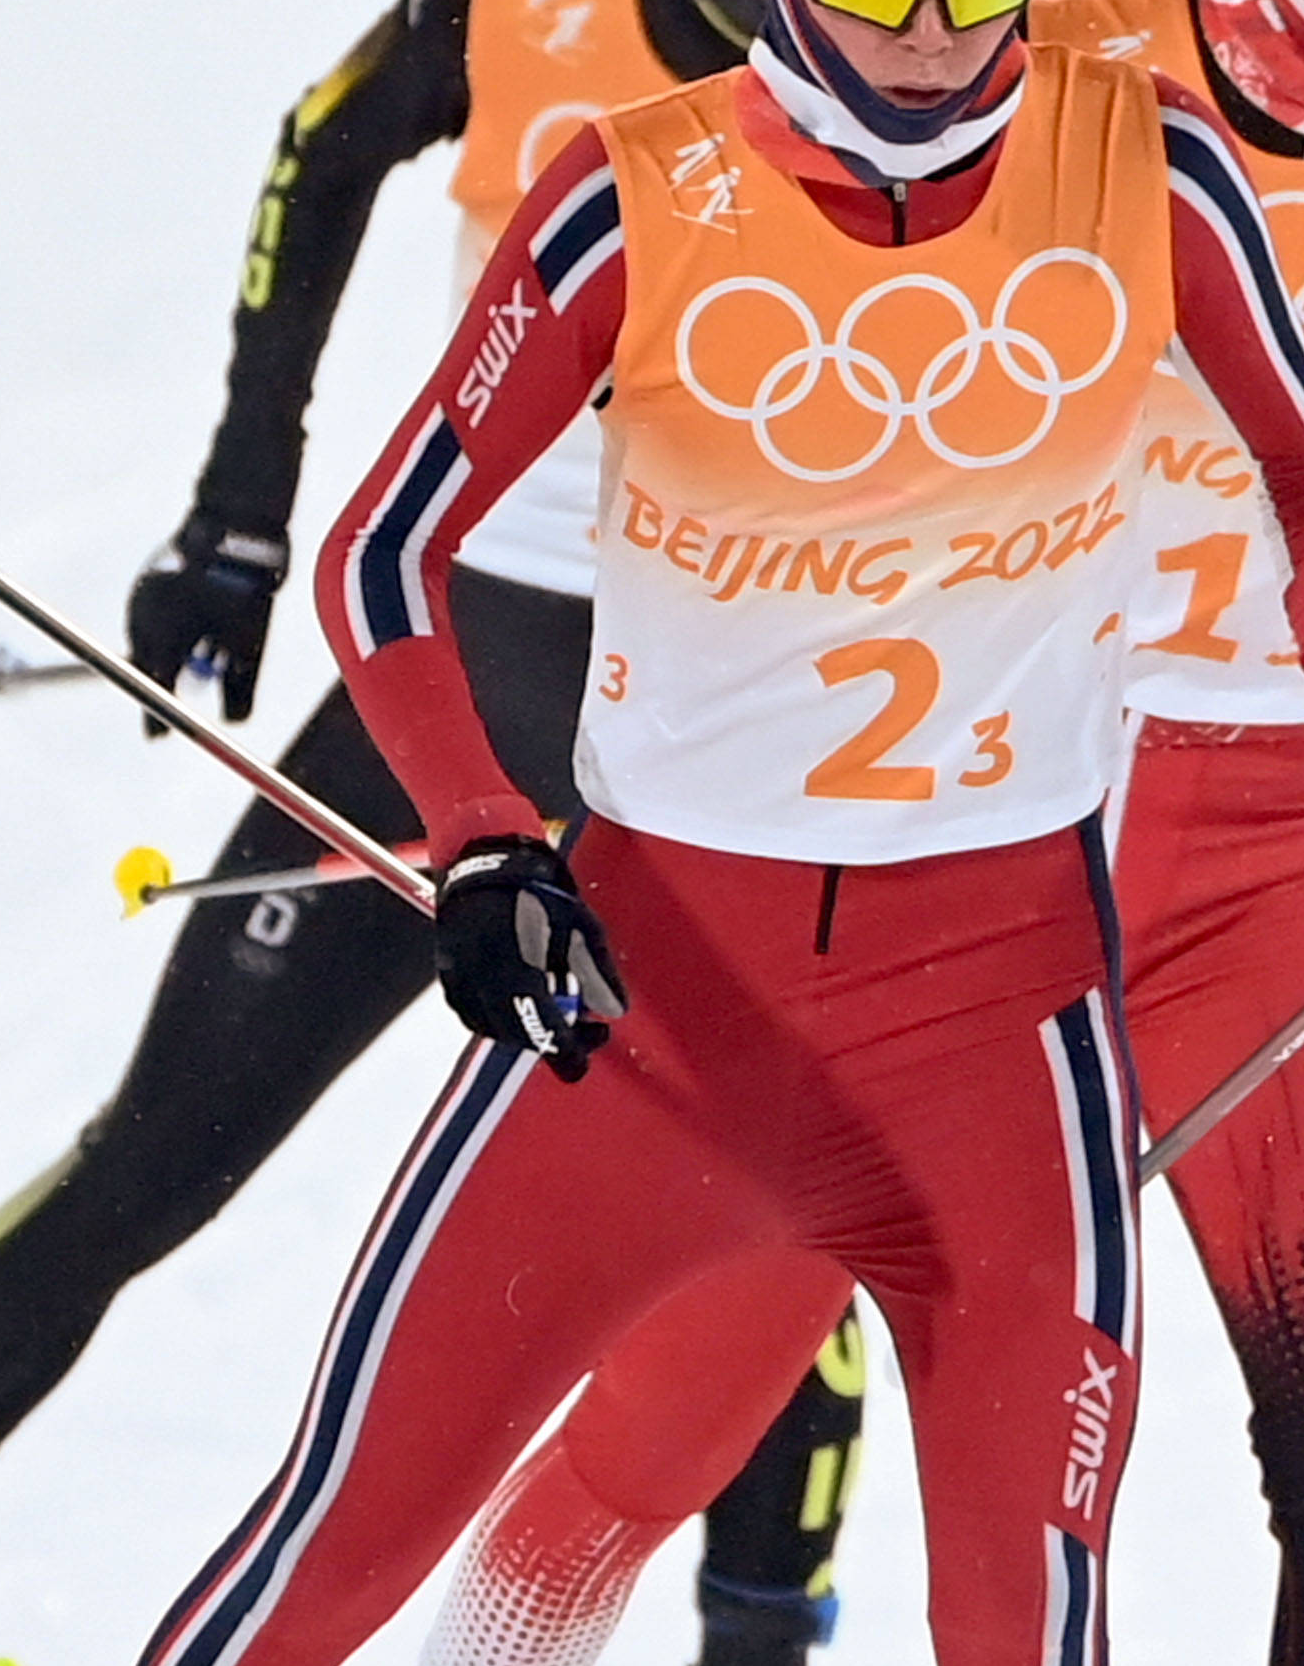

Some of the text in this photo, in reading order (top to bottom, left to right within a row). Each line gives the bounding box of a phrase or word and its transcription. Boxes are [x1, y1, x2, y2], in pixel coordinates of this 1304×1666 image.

[622, 480, 1126, 605] BEIJING 2022
[599, 653, 628, 702] 3
[804, 637, 1014, 801] 2 3
